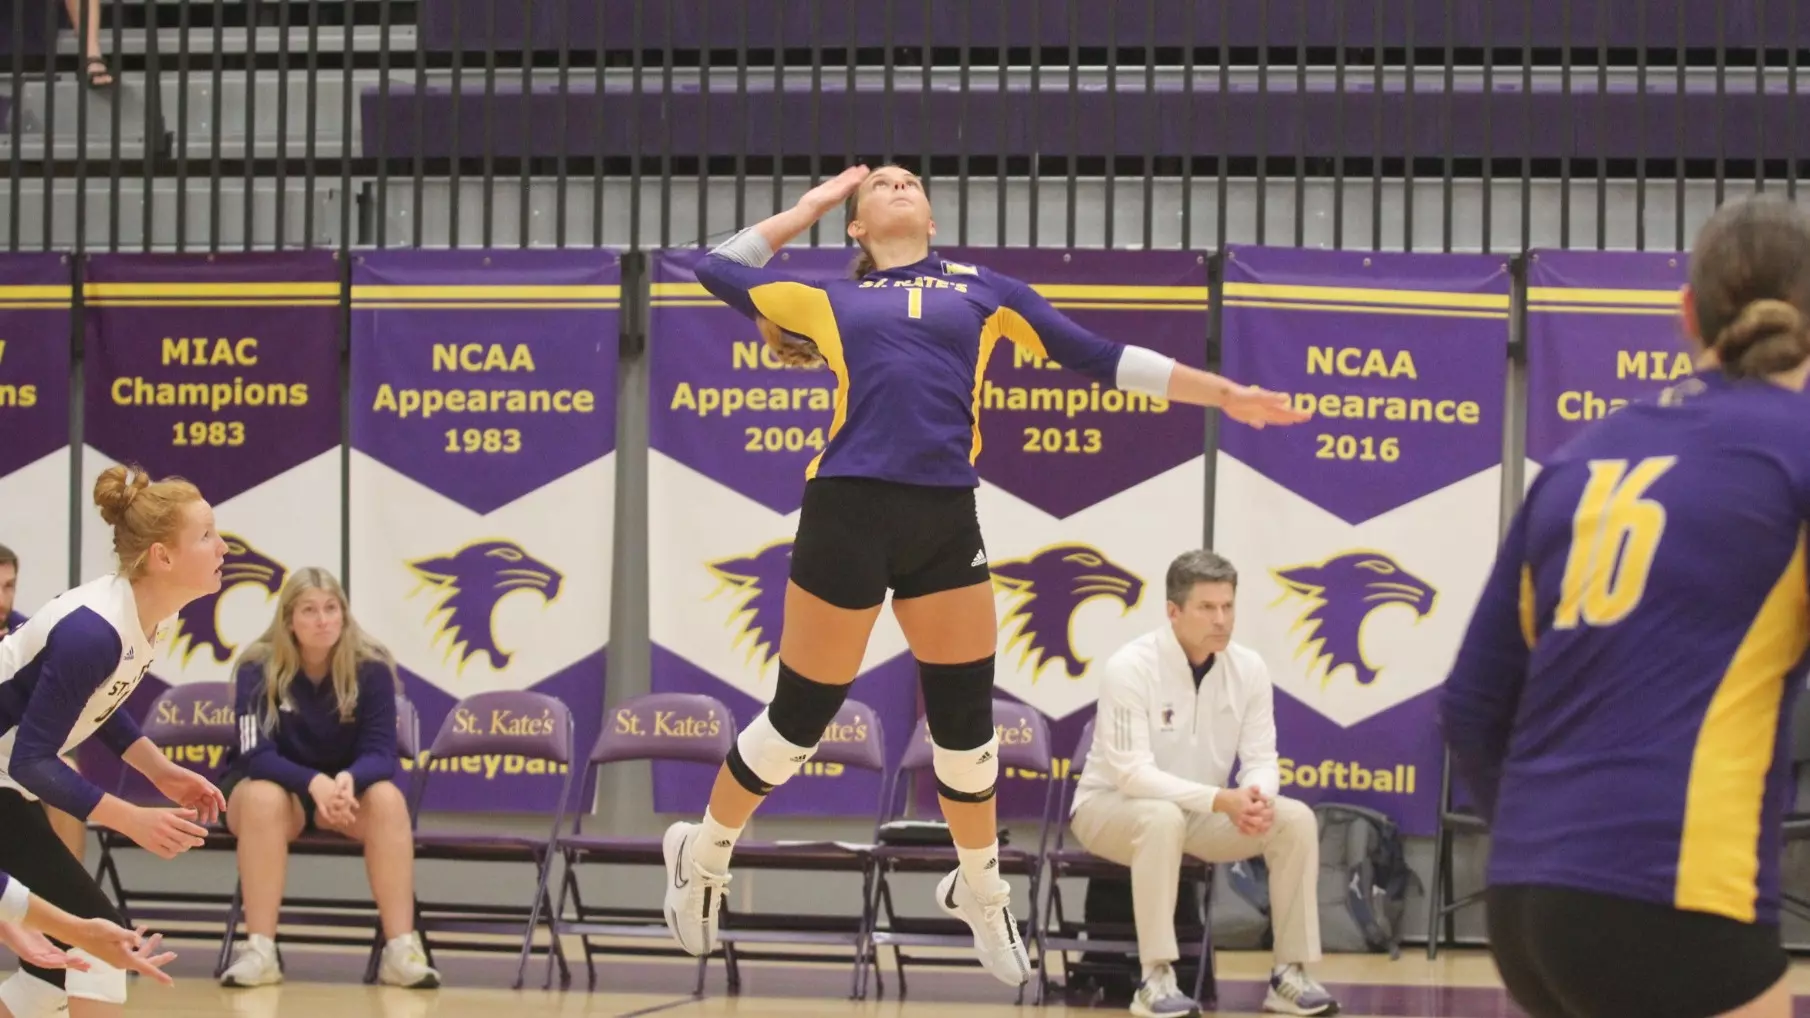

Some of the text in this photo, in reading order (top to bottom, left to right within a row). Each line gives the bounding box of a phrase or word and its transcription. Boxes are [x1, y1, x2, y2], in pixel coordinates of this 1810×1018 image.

[905, 287, 922, 319] 1
[162, 337, 258, 366] MIAC
[432, 343, 535, 372] NCAA
[1307, 346, 1417, 379] NCAA
[1616, 350, 1693, 381] MIA
[111, 377, 308, 412] Champions
[373, 384, 595, 417] Appearance
[670, 382, 837, 416] Appeara
[981, 380, 1170, 418] hampions
[172, 421, 245, 446] 1983
[445, 428, 522, 453] 1983
[744, 427, 825, 452] 2004
[1023, 427, 1102, 454] 2013
[1316, 433, 1400, 462] 2016
[1552, 455, 1678, 630] 16
[156, 701, 186, 725] St.
[452, 709, 556, 736] St. Kate's
[615, 709, 720, 737] St. Kate's
[1277, 758, 1416, 793] Softball
